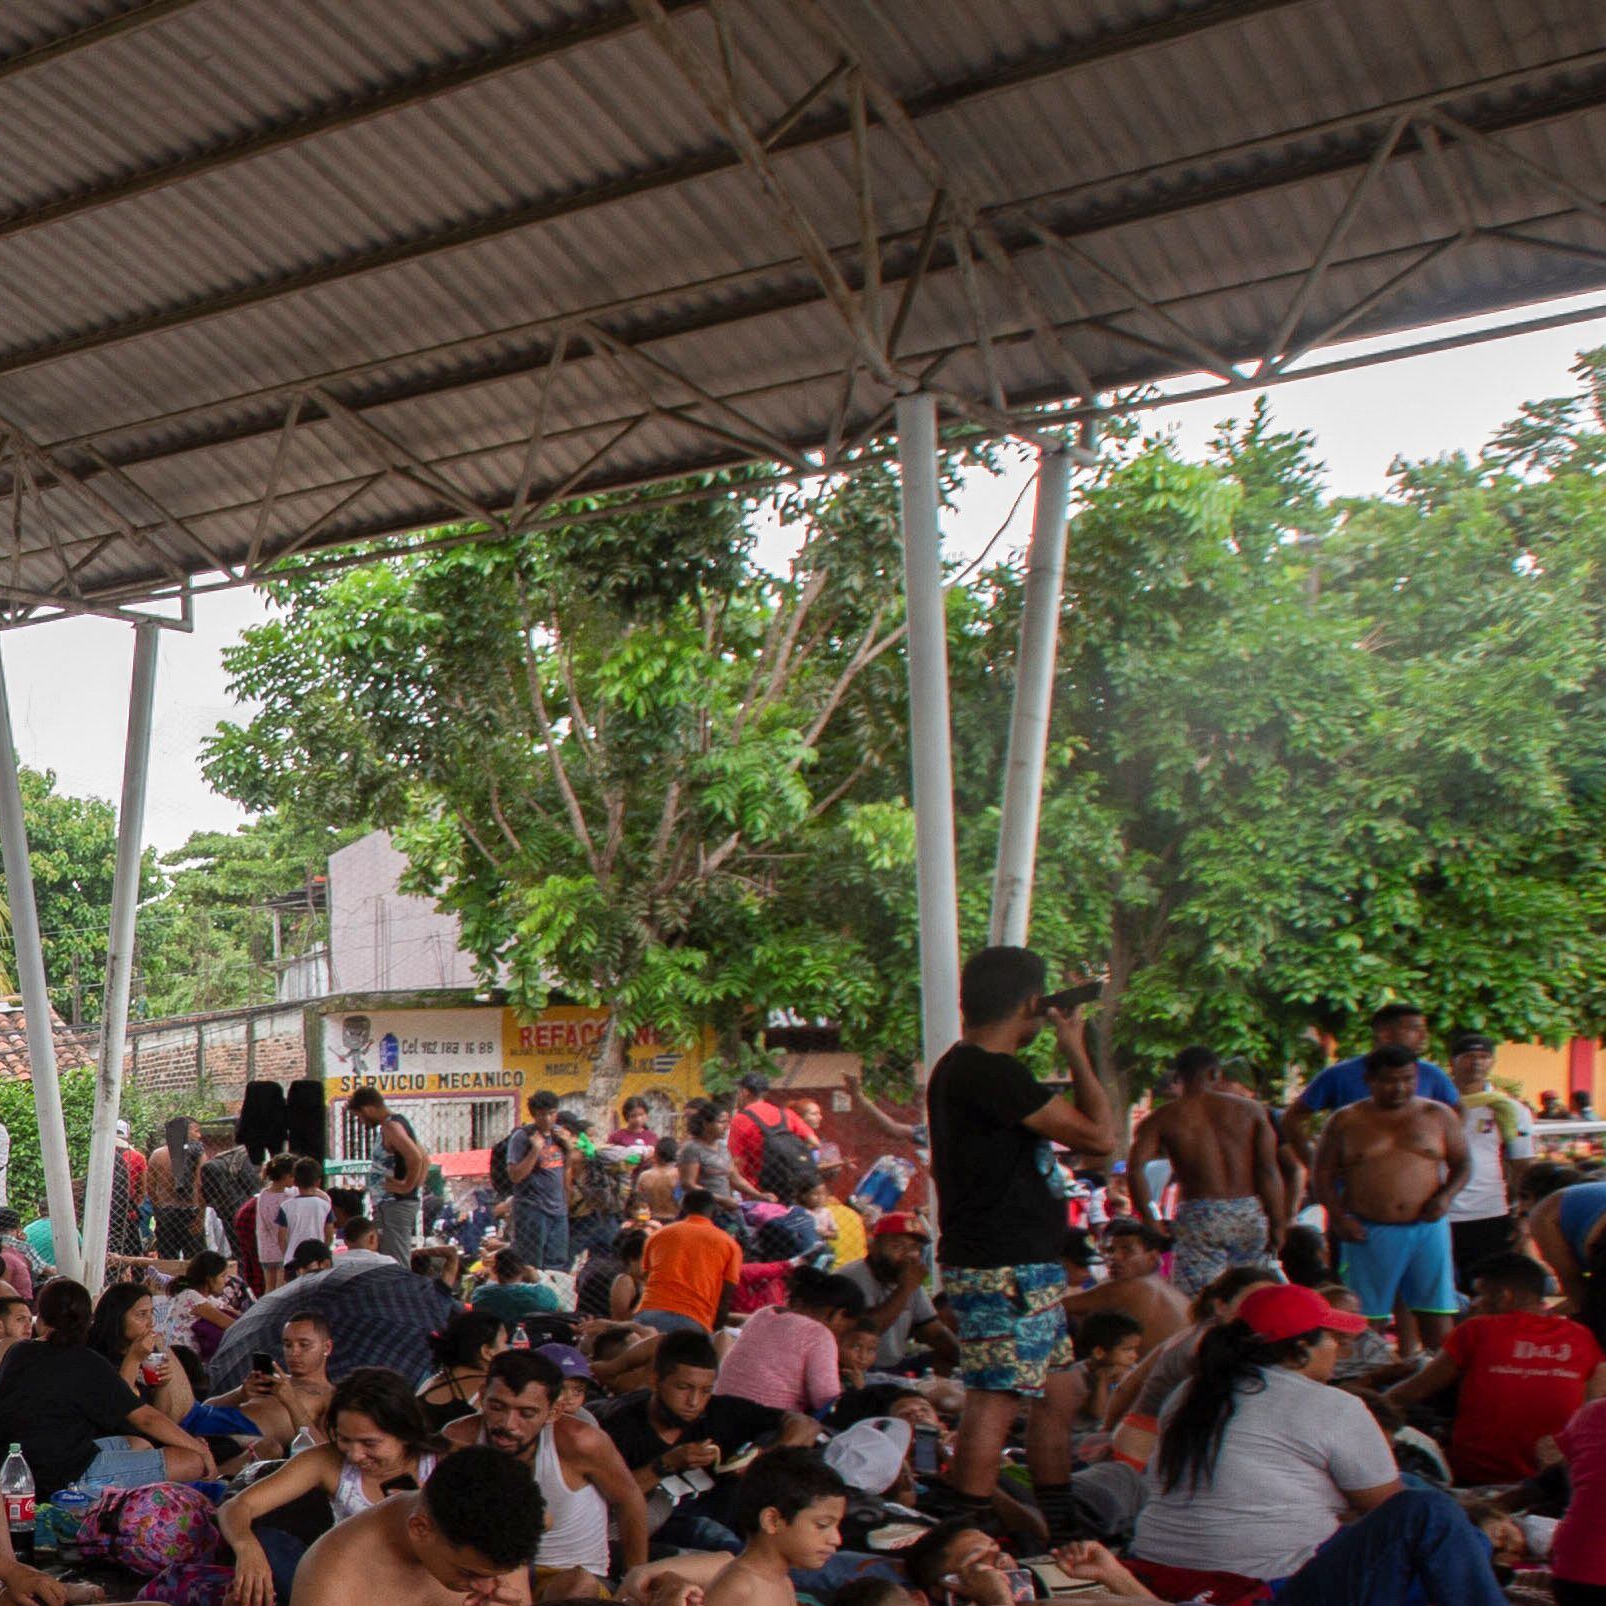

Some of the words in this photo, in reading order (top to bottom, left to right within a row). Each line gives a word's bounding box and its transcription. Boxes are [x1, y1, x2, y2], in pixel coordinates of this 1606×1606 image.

[401, 1039, 418, 1054] Cel
[341, 1073, 425, 1093] SERVICIO
[438, 1071, 524, 1090] MECANICO
